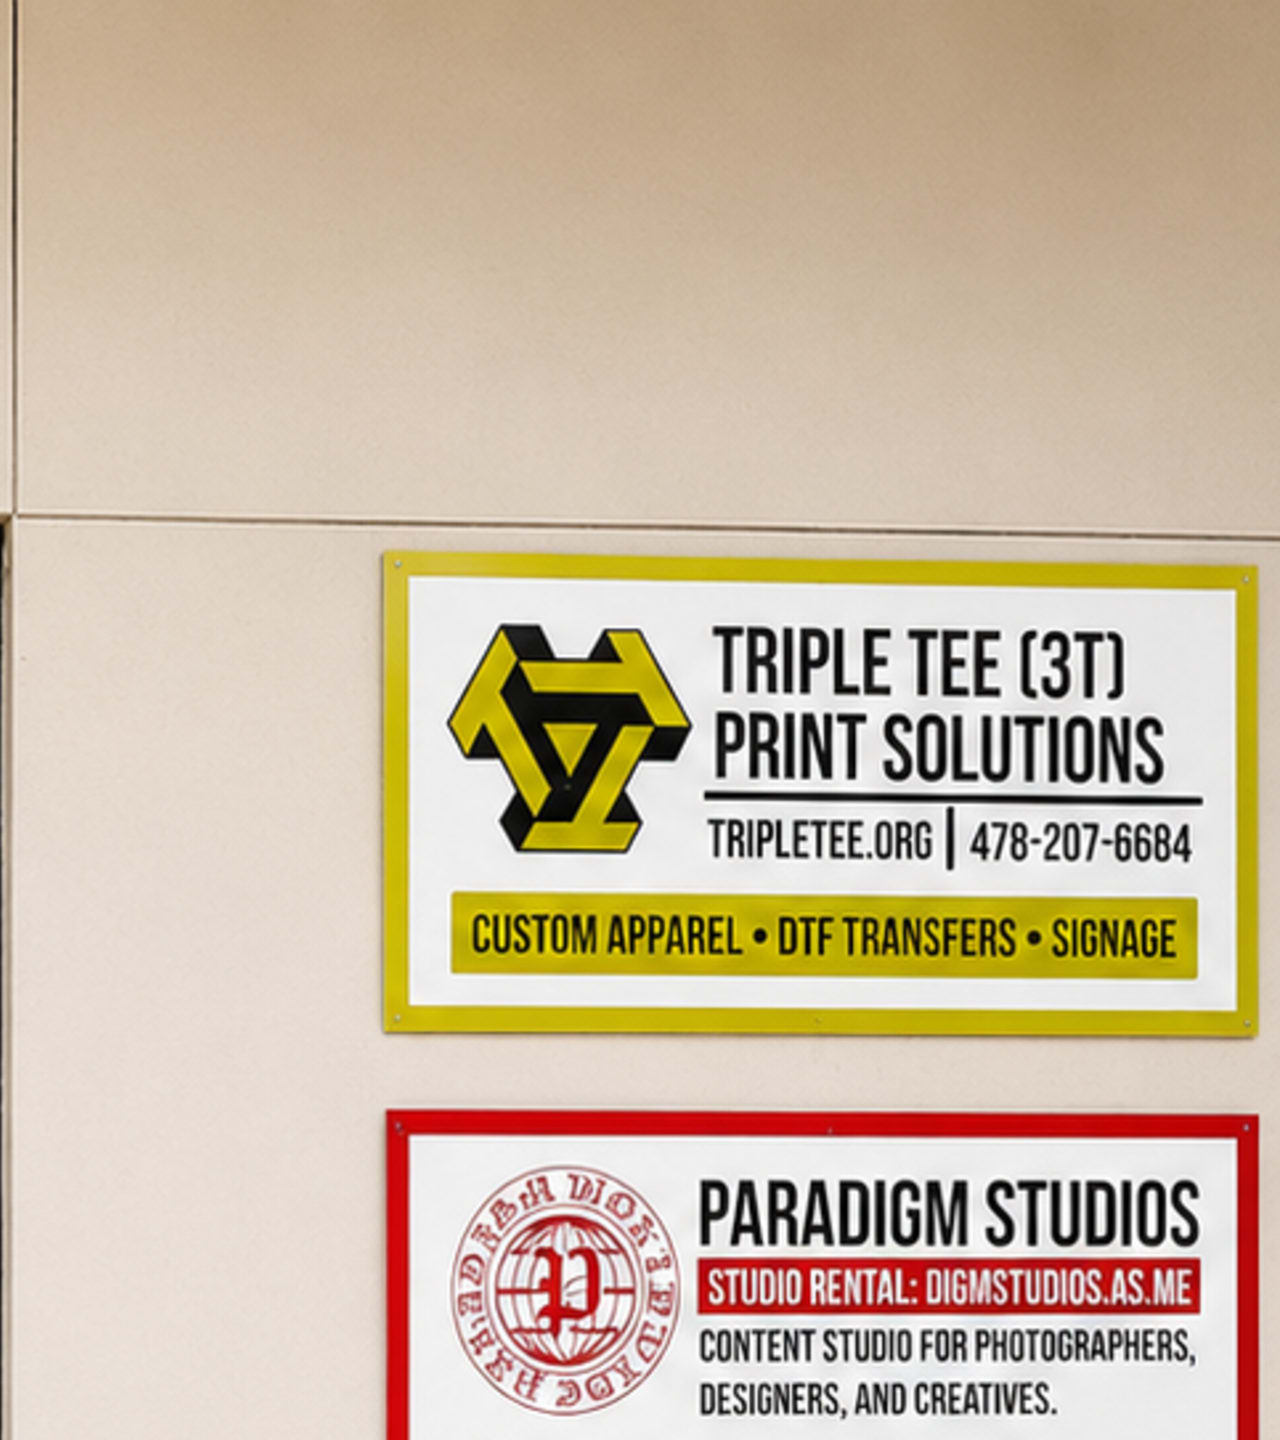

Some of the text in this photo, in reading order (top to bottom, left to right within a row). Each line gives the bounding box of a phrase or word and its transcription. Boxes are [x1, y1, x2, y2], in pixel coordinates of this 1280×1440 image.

[712, 625, 1124, 700] TRIPLE TEE (3T)
[716, 711, 1164, 785] PRINT SOLUTIONS
[707, 818, 1192, 863] TRIPLETEE.ORG 478-207-6684
[472, 913, 1177, 959] CUSTOM APPAREL DTF TRANSFERS SIGNAGE
[700, 1179, 1199, 1247] PARADIGM STUDIOS
[708, 1268, 1193, 1306] STUDIO RENTAL: DIGMSTUDIOS.AS.ME
[700, 1328, 1196, 1366] CONTENT STUDIO FOR PHOTOGRAPHERS,
[700, 1381, 1058, 1420] DESIGNERS, AND CREATIVES.
